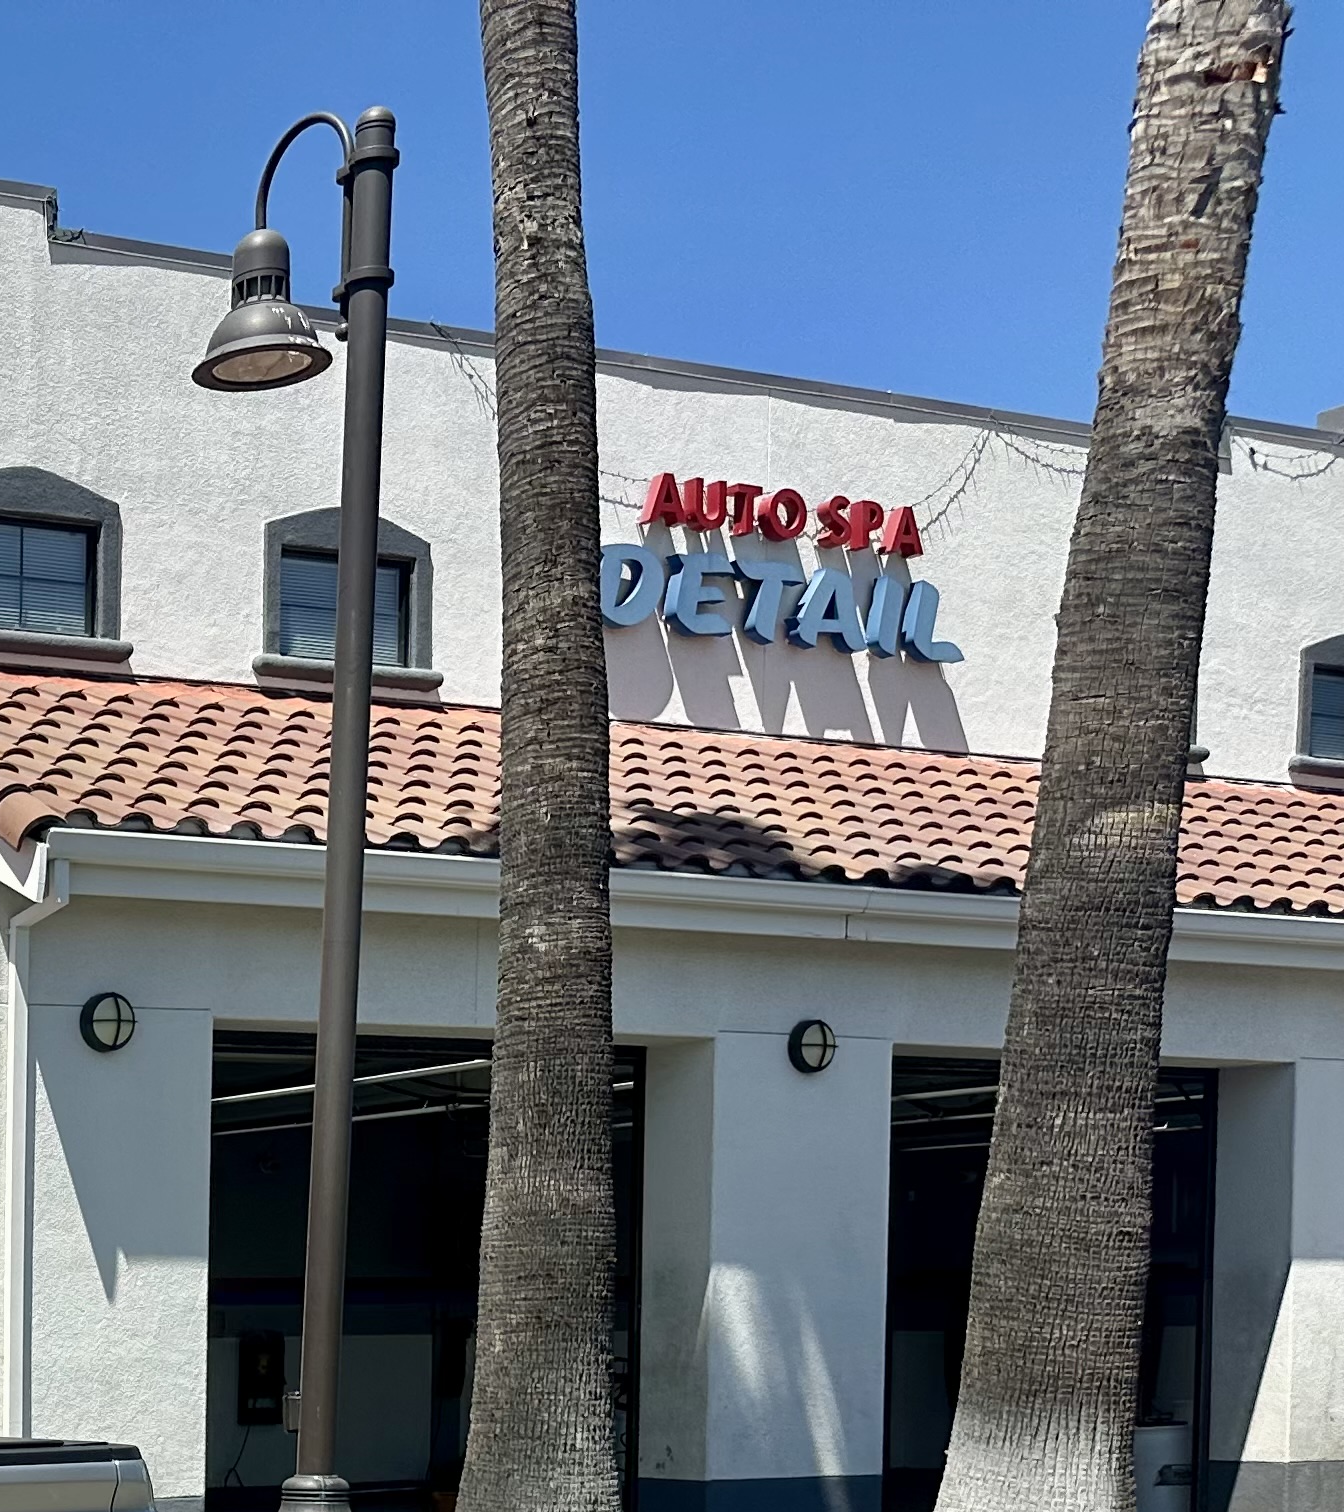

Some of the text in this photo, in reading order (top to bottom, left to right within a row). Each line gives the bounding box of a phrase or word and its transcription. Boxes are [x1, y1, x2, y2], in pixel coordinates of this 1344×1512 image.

[639, 472, 924, 558] AUTO SPA
[600, 543, 965, 664] DETAIL
